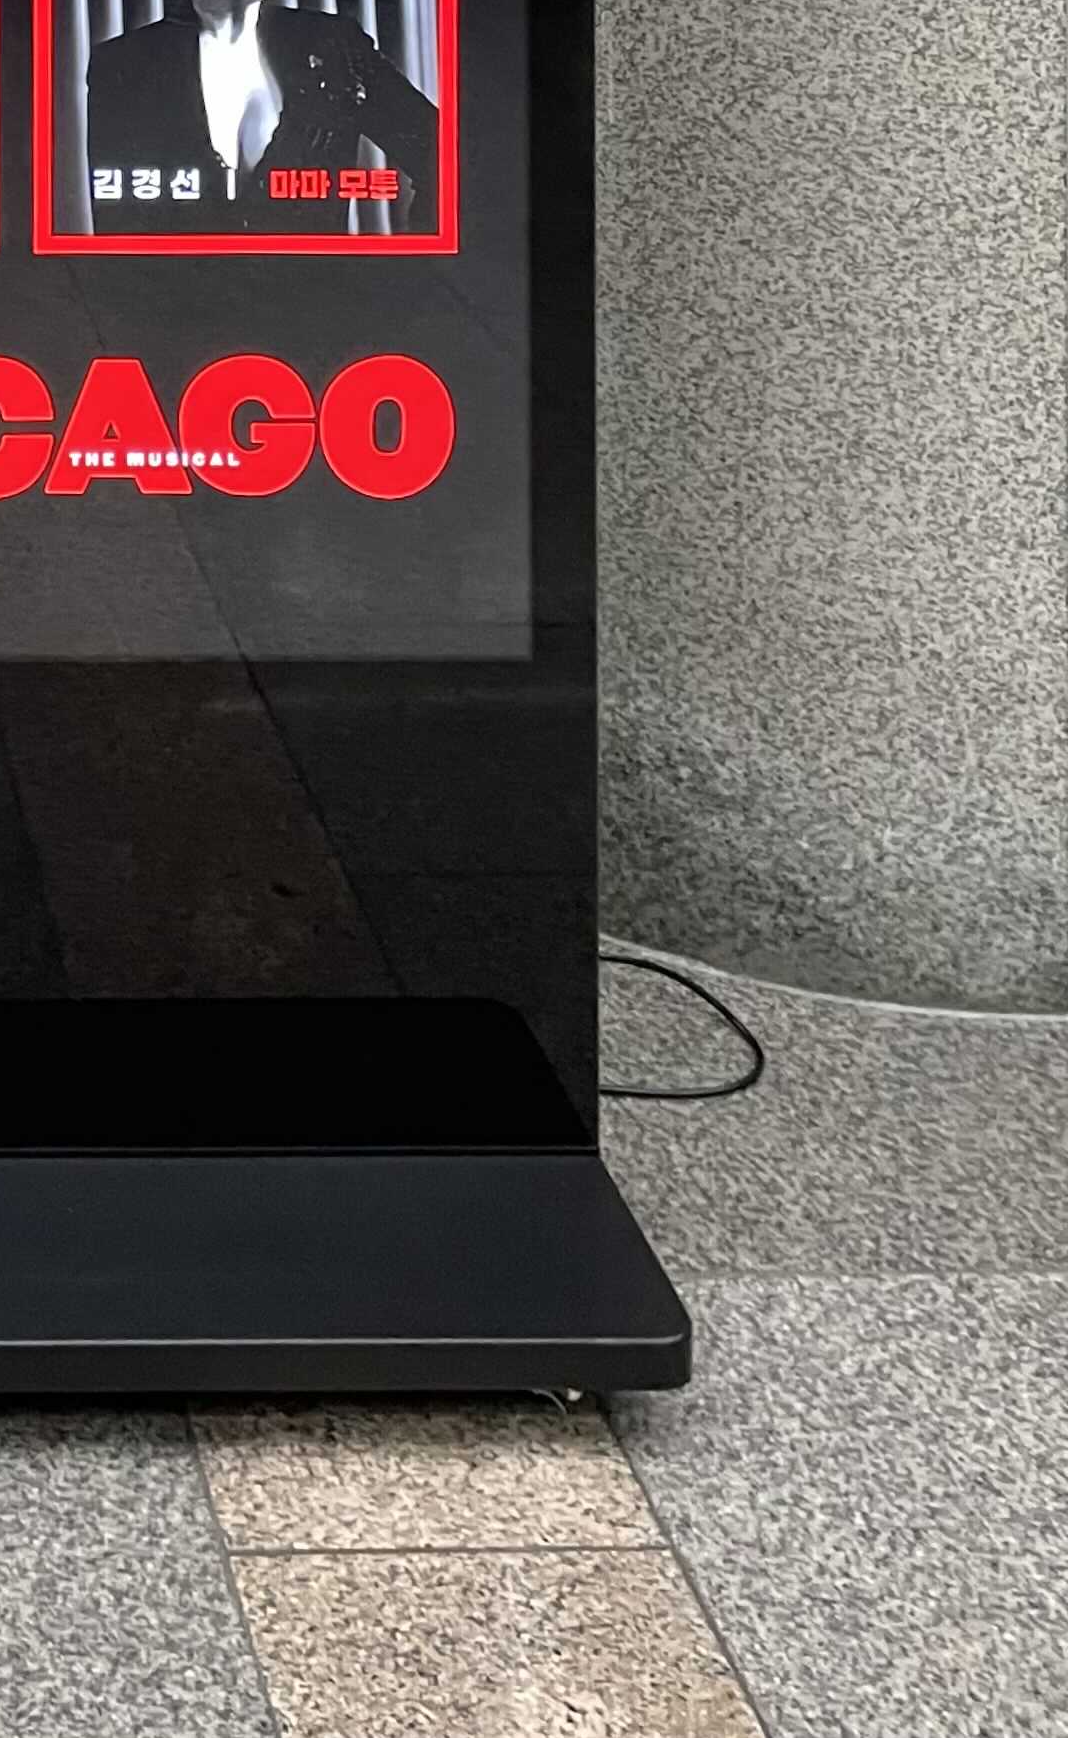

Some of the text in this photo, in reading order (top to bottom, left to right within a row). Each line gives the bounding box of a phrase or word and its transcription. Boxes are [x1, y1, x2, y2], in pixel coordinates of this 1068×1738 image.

[270, 169, 330, 199] 마마
[338, 169, 398, 199] 모튼
[69, 452, 241, 467] THE MUSICAL
